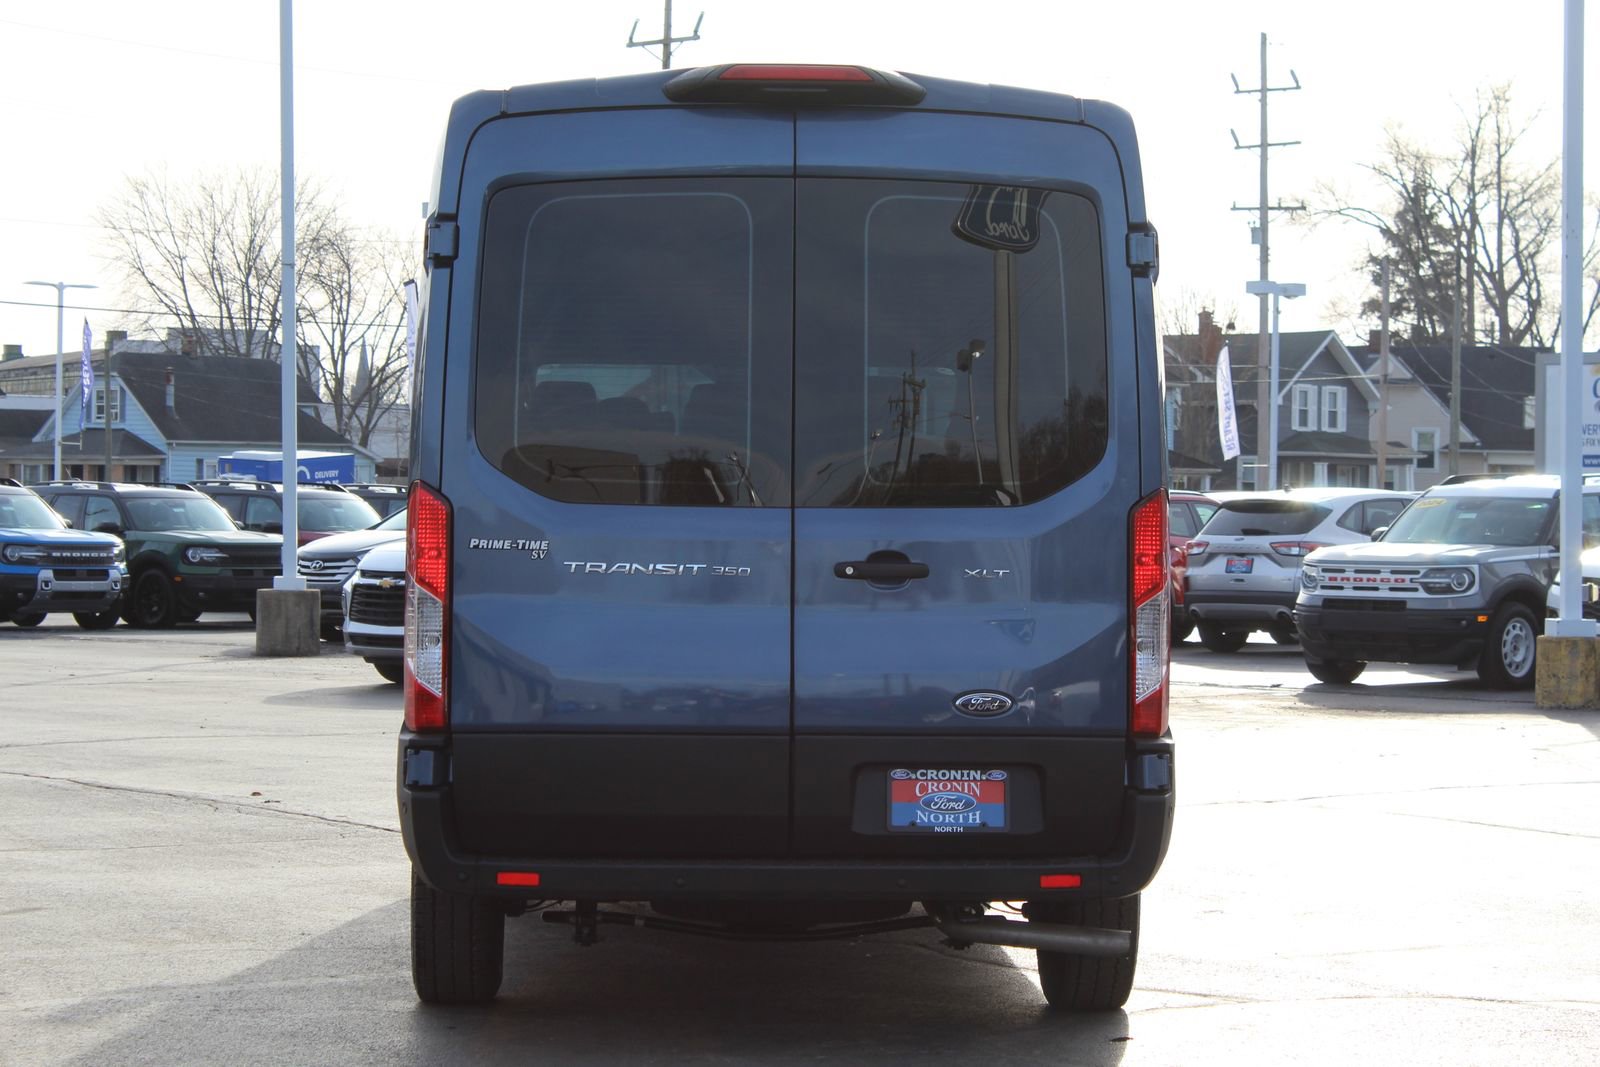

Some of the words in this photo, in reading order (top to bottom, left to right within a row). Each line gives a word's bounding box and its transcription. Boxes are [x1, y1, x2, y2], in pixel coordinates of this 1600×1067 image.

[314, 470, 339, 479] DELIVERY
[469, 538, 549, 550] PRIME-TIME
[531, 550, 547, 560] SV
[563, 561, 707, 577] TRANSIT
[711, 566, 751, 577] 350
[963, 568, 1010, 578] XLT
[1327, 576, 1406, 584] BRONCO
[968, 697, 1000, 711] Ford
[916, 769, 981, 780] CRONIN
[915, 781, 981, 797] CRONIN
[930, 794, 966, 810] Ford
[915, 810, 981, 823] NORTH
